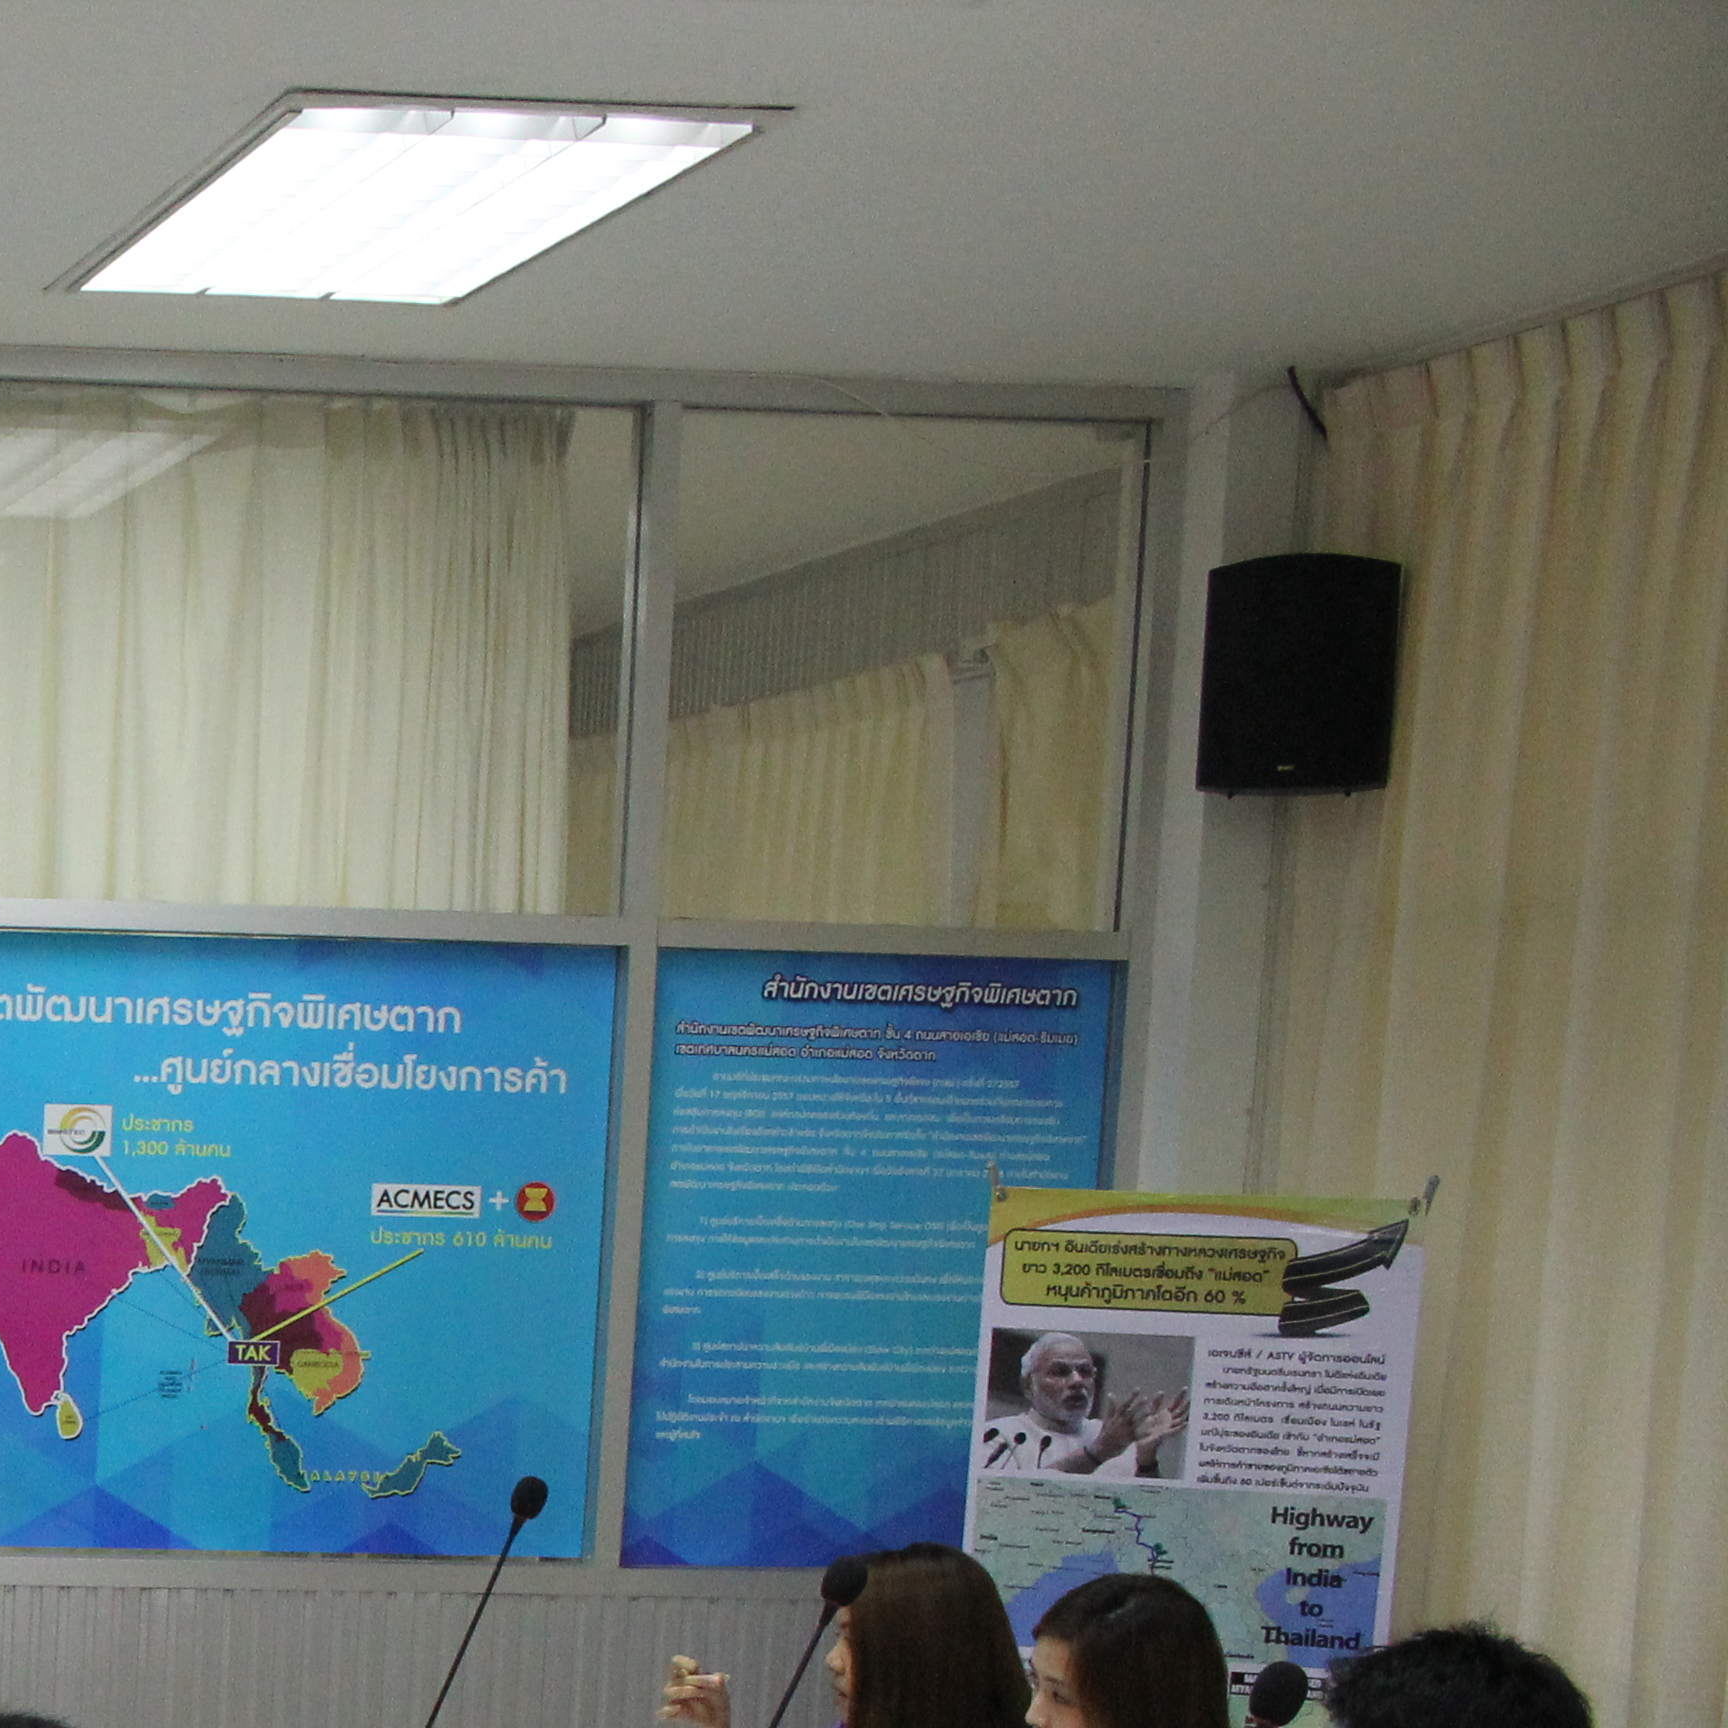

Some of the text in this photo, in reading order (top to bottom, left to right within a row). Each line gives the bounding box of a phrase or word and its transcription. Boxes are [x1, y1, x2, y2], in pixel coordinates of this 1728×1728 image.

[763, 975, 1078, 1010] สำนักงานเขตเศรษฐกิจพิเศษตาก
[121, 1113, 194, 1132] ประชากร
[122, 1139, 232, 1157] 1,300 ล้านคน
[376, 1188, 475, 1211] ACMECS
[371, 1226, 554, 1249] ประชากร 610 ล้านคน
[22, 1259, 87, 1274] INDIA
[1052, 1263, 1092, 1277] 3,200
[1204, 1289, 1225, 1303] 60
[1231, 1290, 1247, 1304] %
[235, 1344, 272, 1362] TAK
[1267, 1351, 1294, 1361] ASTV
[1271, 1506, 1375, 1534] Highway
[1289, 1537, 1345, 1559] from
[1285, 1567, 1343, 1589] India
[1299, 1600, 1324, 1617] to
[1261, 1626, 1361, 1650] Thailand
